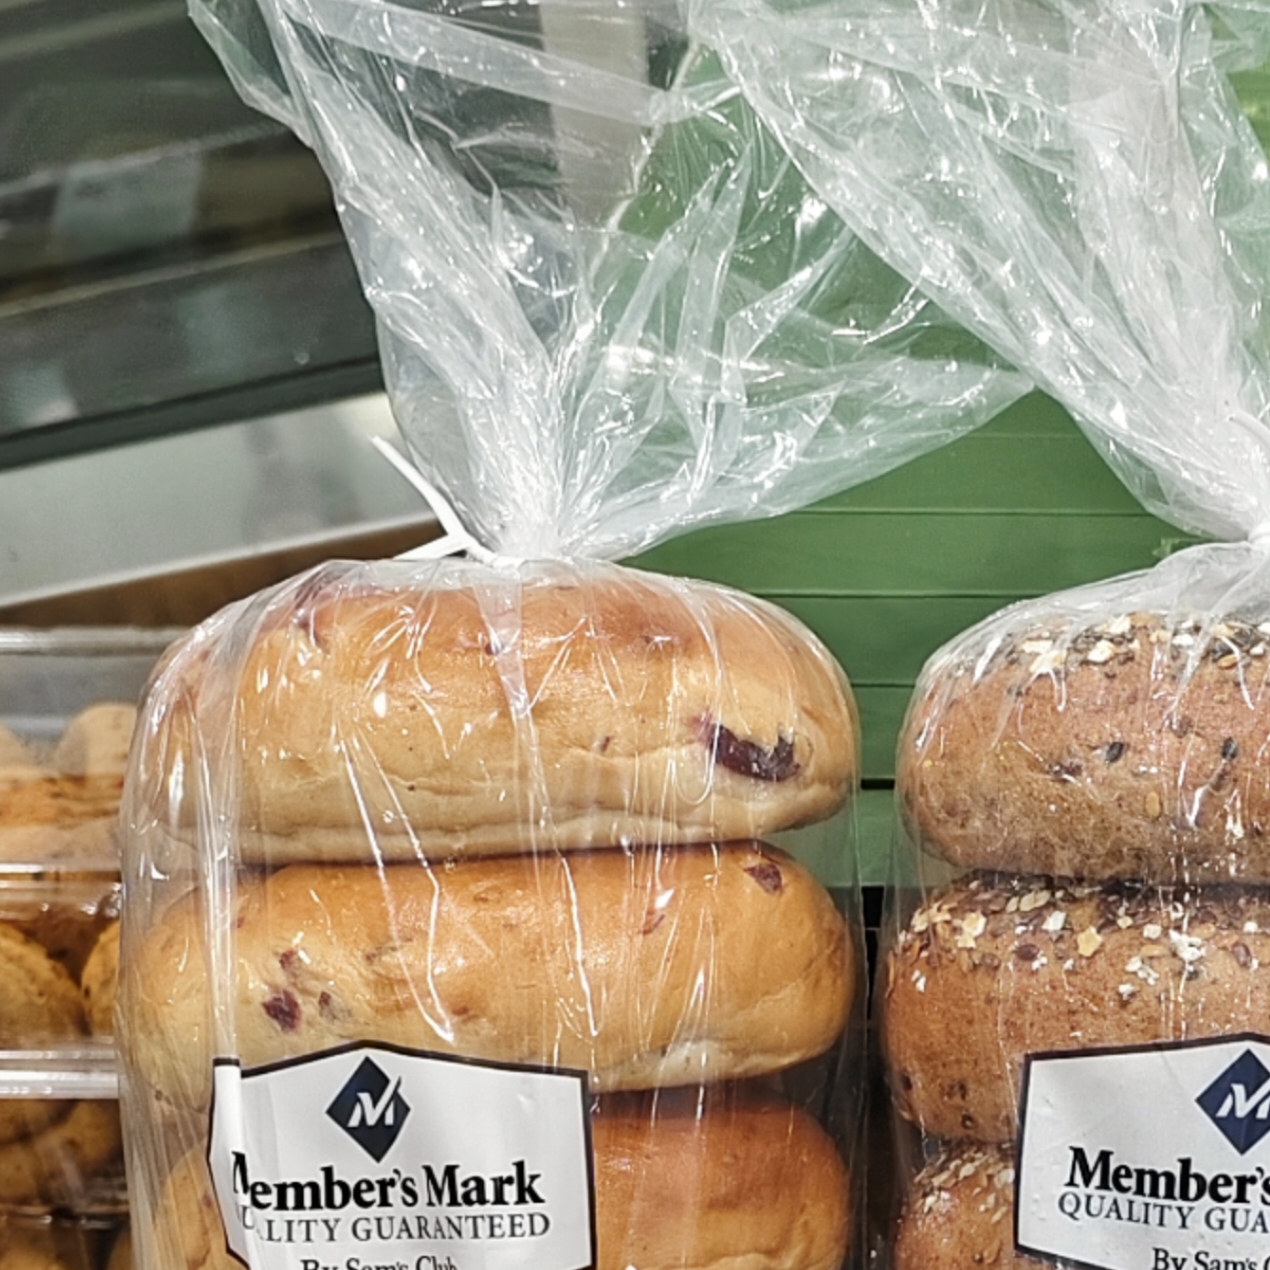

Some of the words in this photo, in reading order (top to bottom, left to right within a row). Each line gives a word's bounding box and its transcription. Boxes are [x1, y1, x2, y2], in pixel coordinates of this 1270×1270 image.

[422, 1159, 546, 1208] Mark
[352, 1212, 550, 1242] GUARANTEED
[1058, 1192, 1195, 1230] QUALITY
